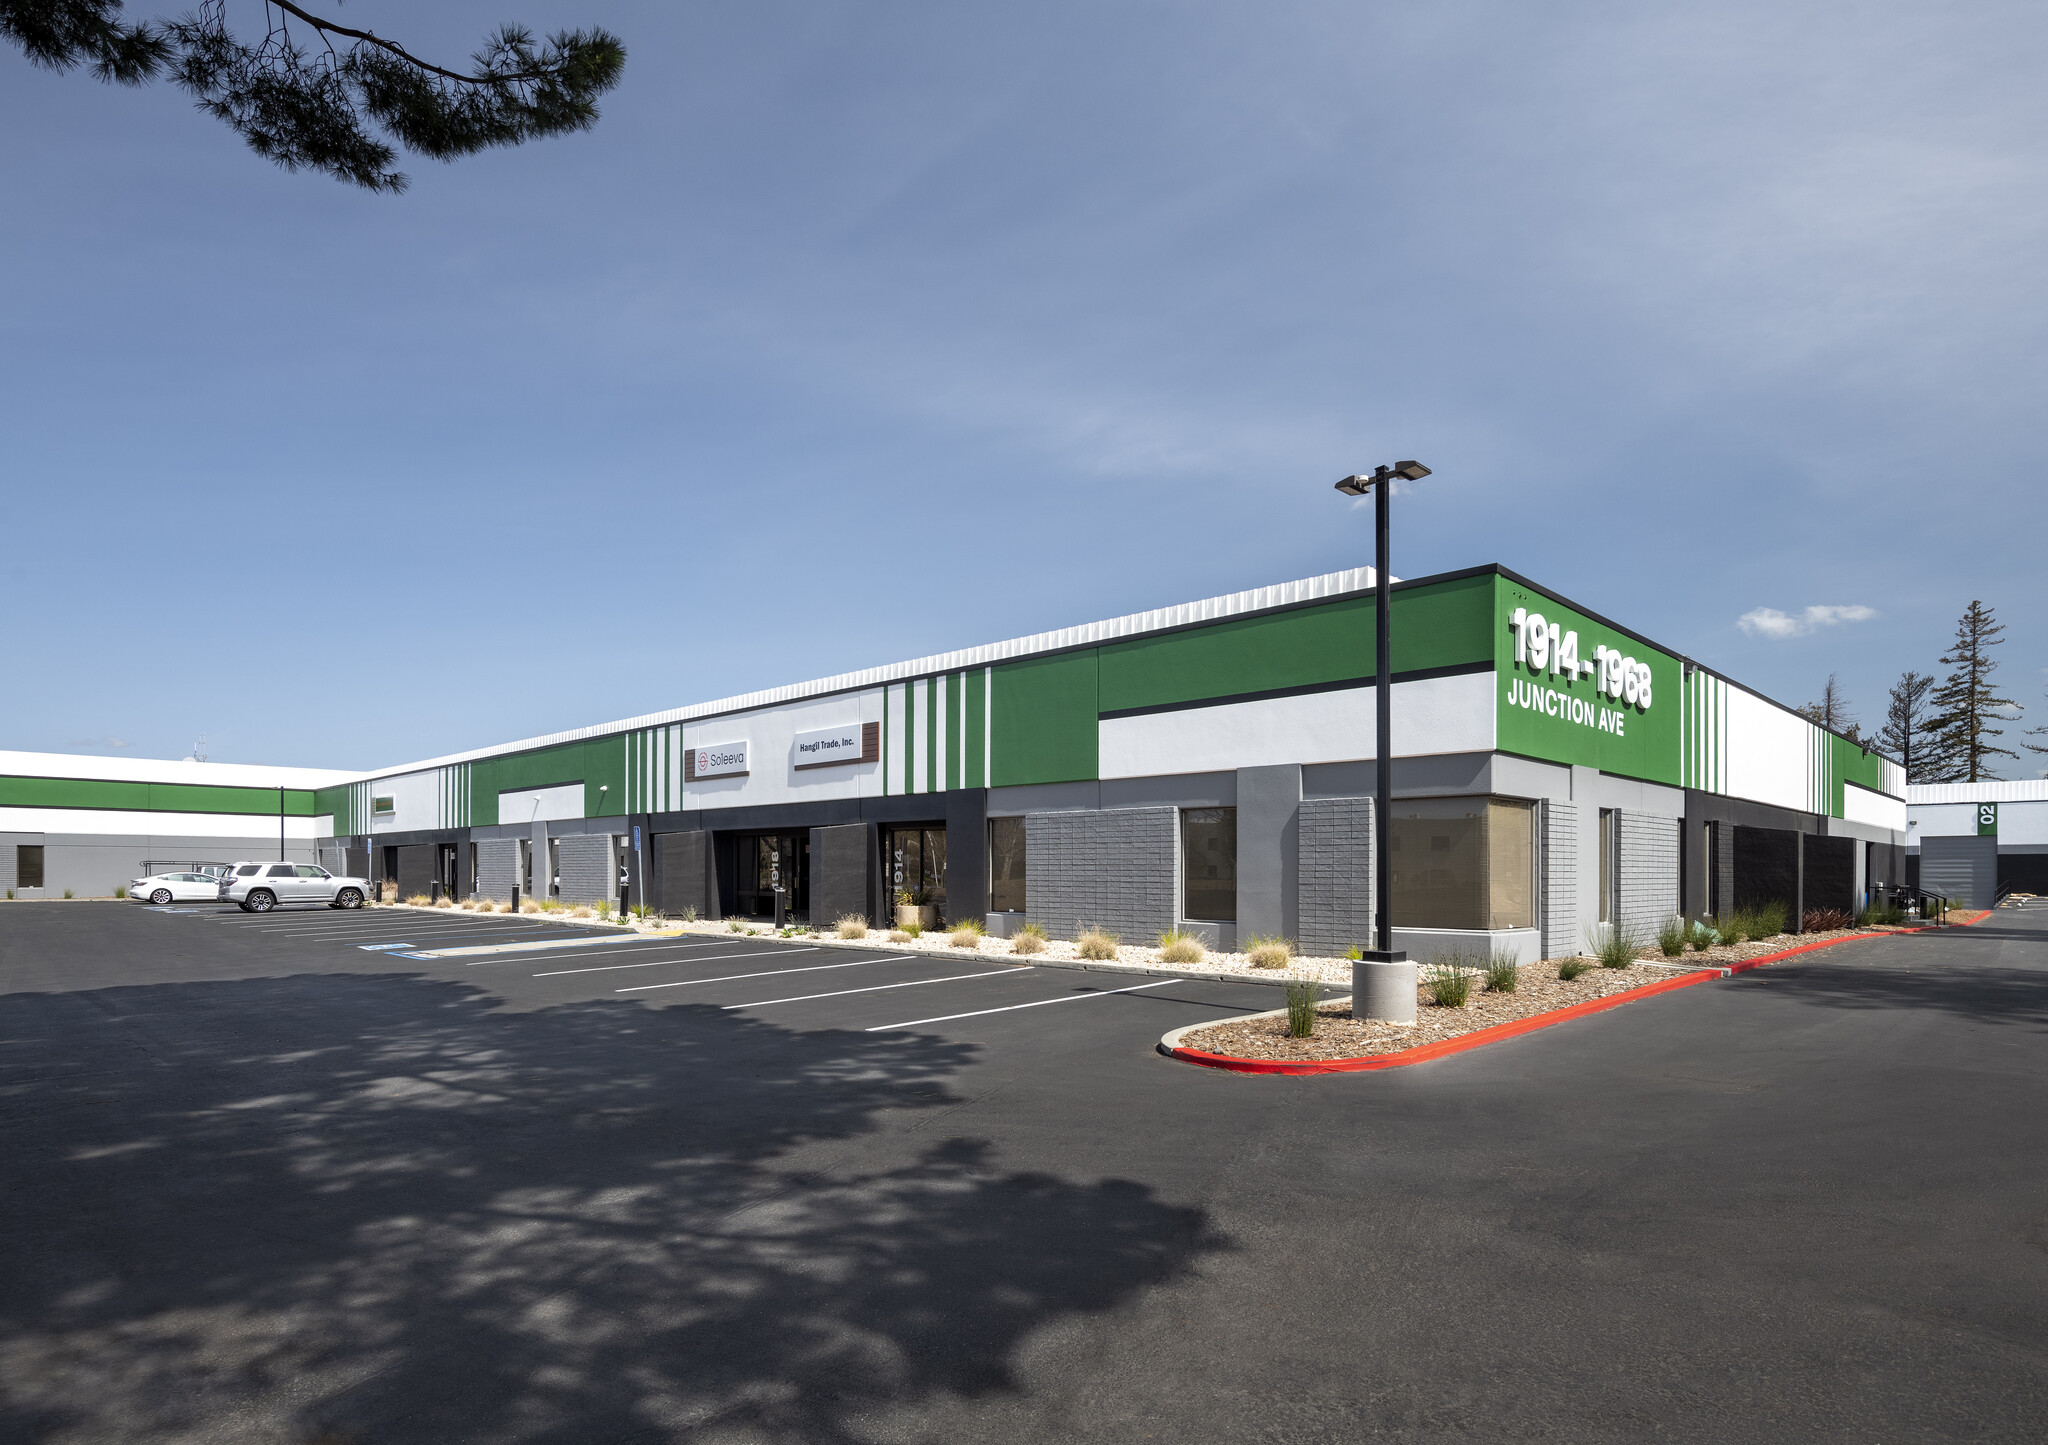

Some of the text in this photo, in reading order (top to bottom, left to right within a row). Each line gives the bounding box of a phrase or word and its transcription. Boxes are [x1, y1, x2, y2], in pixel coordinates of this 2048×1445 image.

[1508, 607, 1652, 709] 1914-1968
[1508, 678, 1625, 737] JUNCTION AVE
[710, 753, 744, 767] Soleeva
[800, 738, 854, 753] Hangil Trade, Inc.
[1980, 805, 1995, 825] 02
[894, 849, 903, 892] 1914
